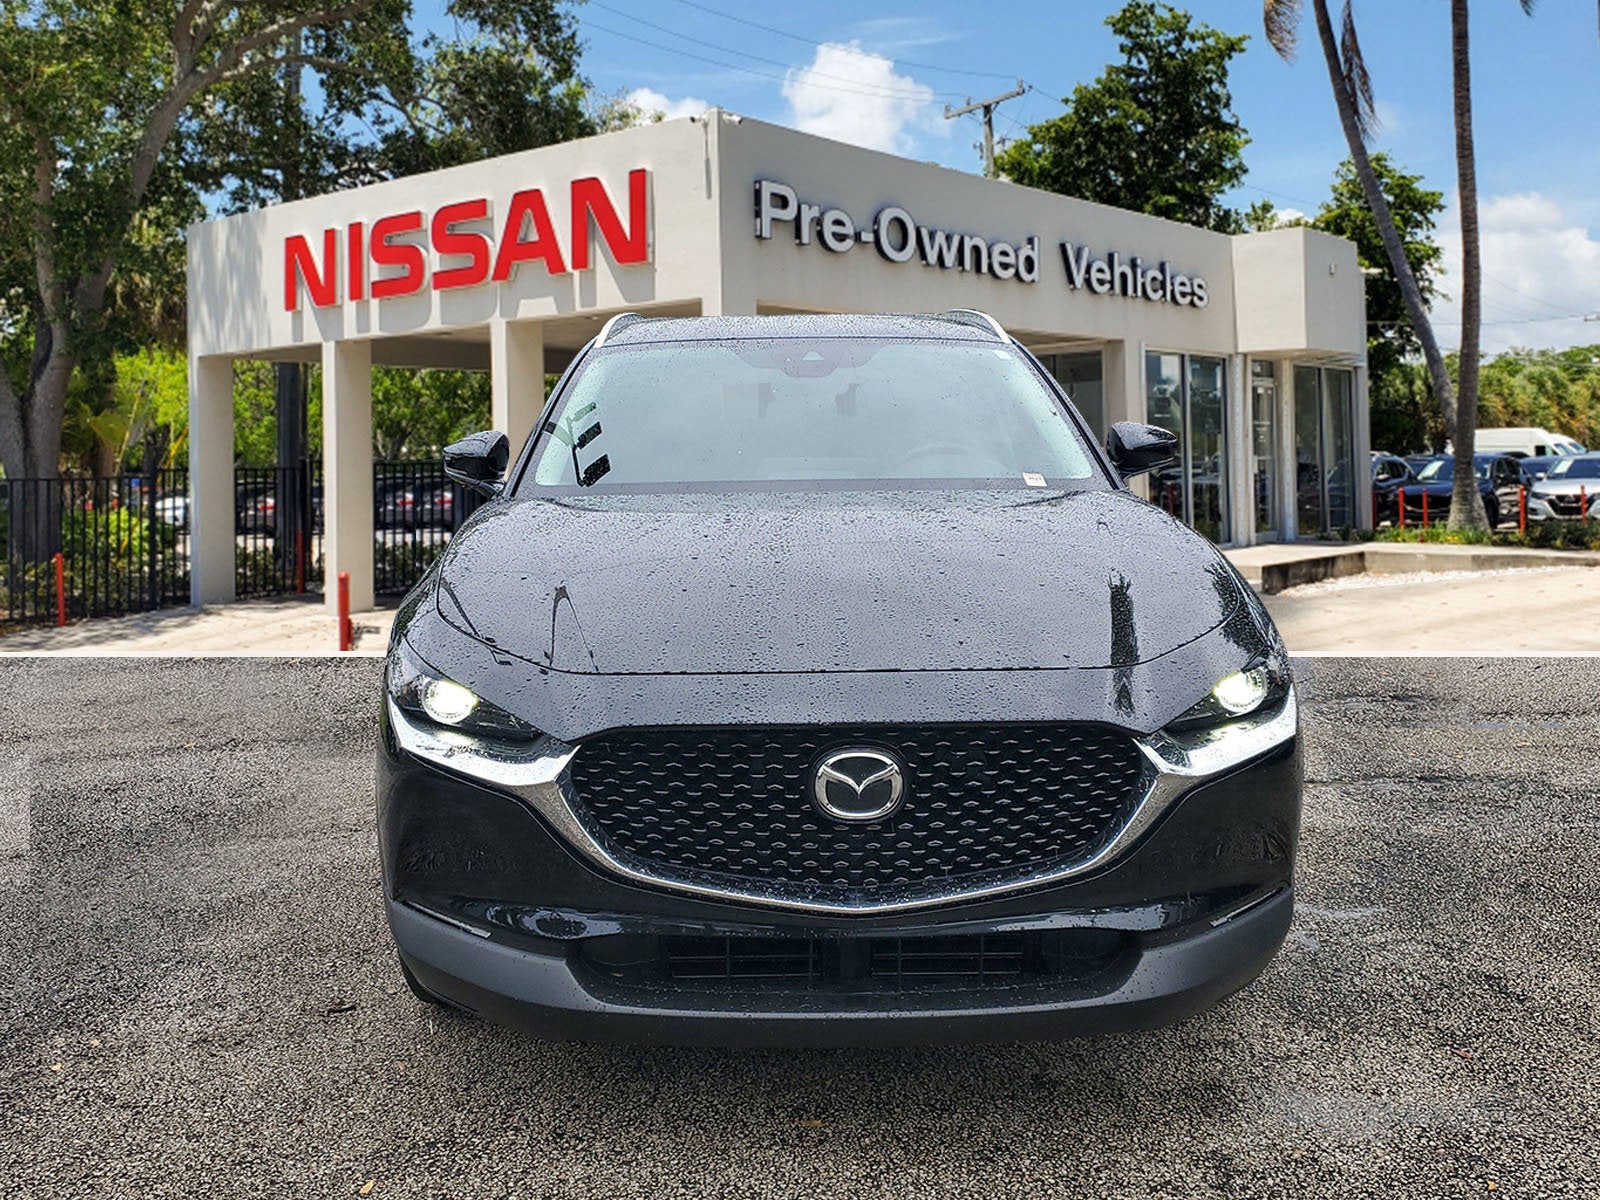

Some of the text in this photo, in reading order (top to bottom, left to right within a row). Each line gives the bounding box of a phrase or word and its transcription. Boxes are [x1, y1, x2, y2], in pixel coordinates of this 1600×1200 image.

[284, 168, 648, 312] NISSAN
[755, 180, 1209, 309] Pre-Owned Vehicles
